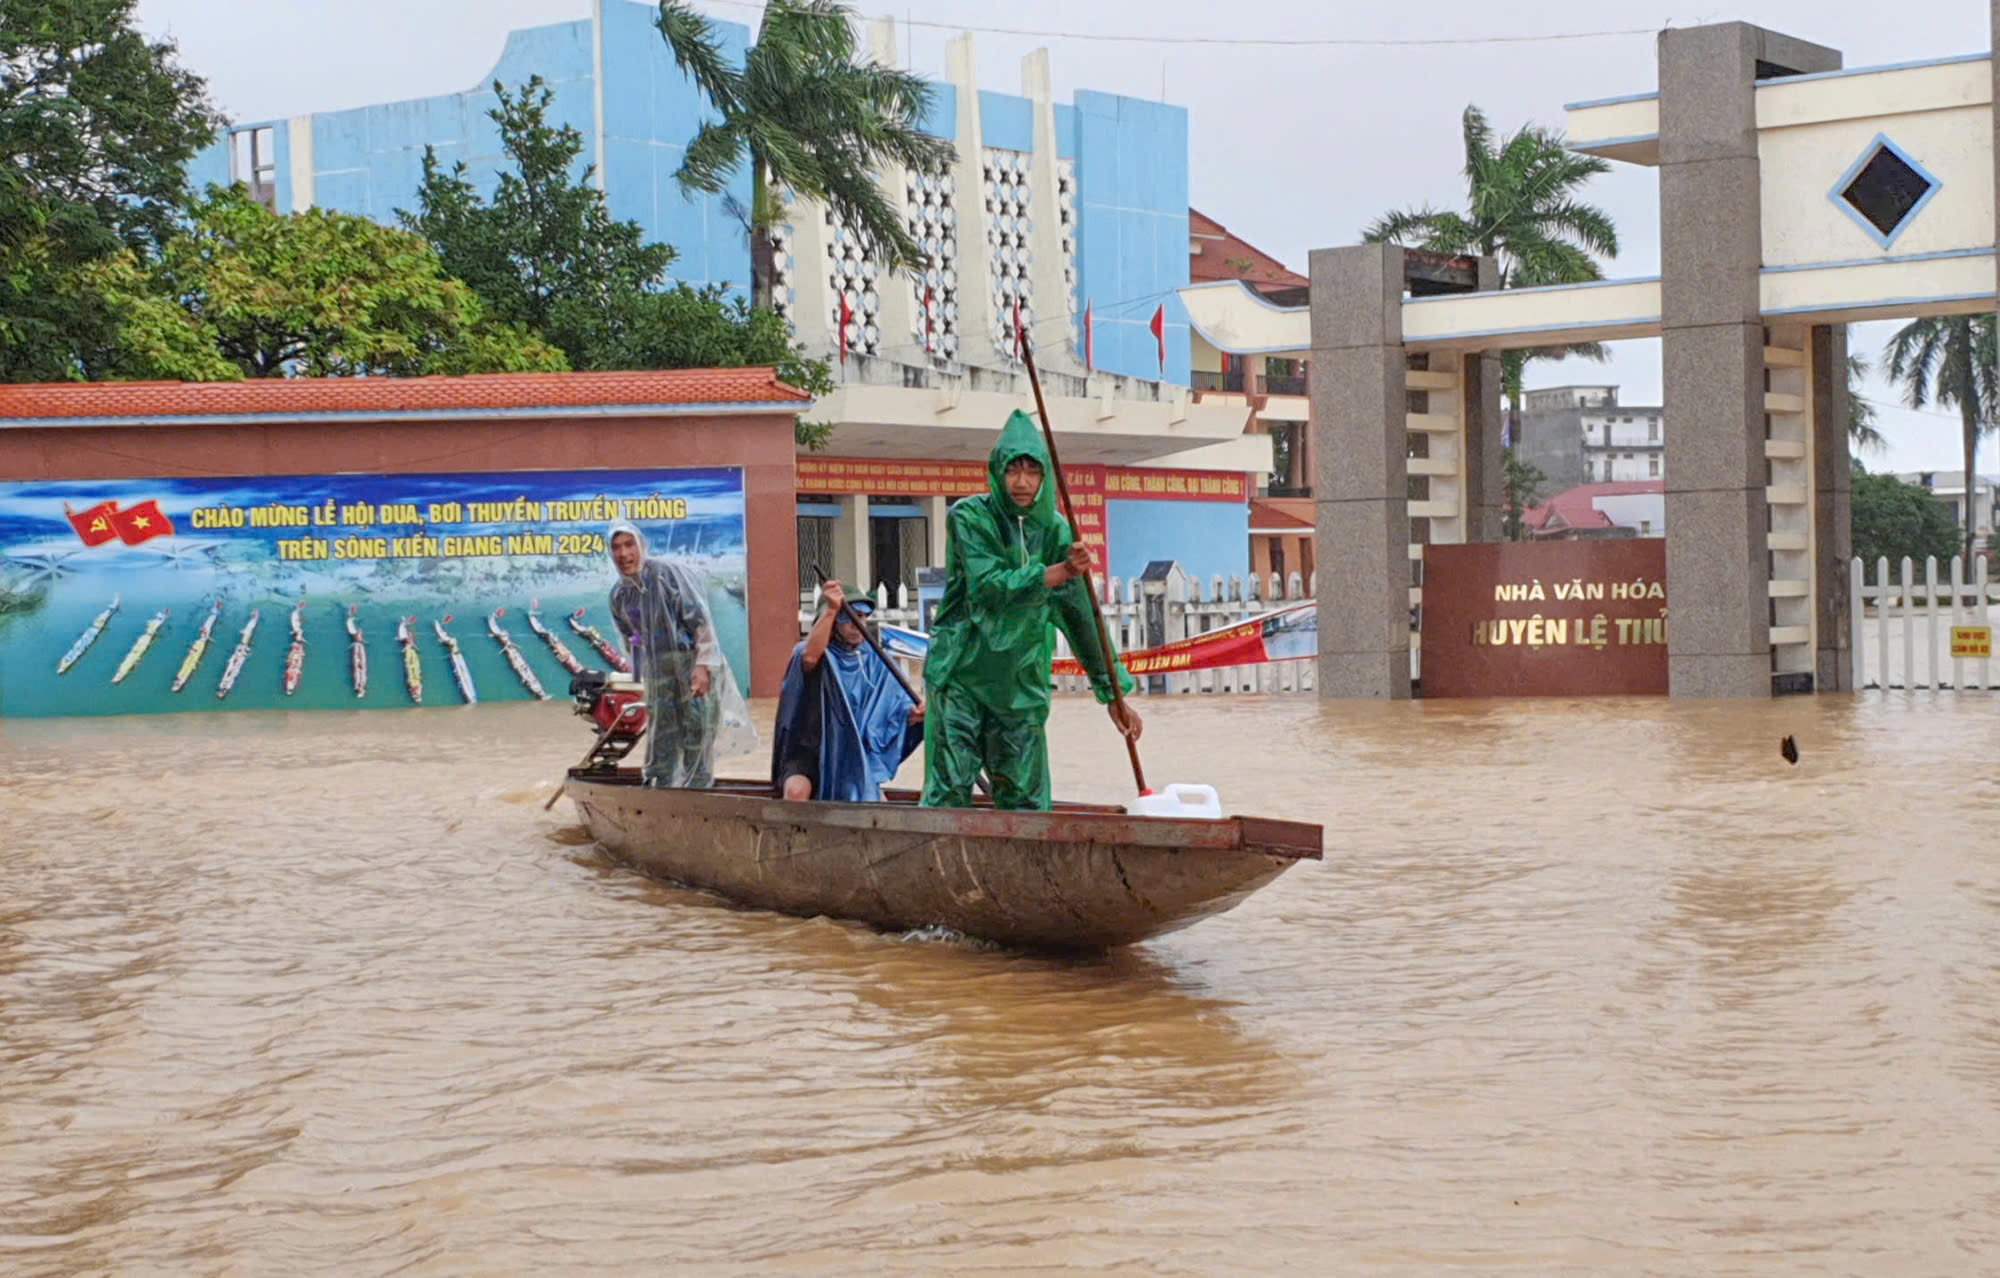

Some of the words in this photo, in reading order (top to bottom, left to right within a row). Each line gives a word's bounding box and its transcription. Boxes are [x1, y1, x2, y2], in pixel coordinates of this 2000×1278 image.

[191, 504, 245, 529] CHÀO
[250, 502, 309, 527] MỪNG
[314, 498, 337, 525] LỄ
[342, 501, 374, 530] HỘI
[380, 504, 424, 526] ĐUA,
[429, 501, 462, 524] BƠI
[468, 496, 541, 523] THUYỀN
[546, 494, 619, 521] TRUYỀN
[624, 491, 687, 520] THỐNG
[278, 536, 329, 560] TRÊN
[334, 535, 387, 559] SÔNG
[392, 531, 438, 558] KIẾN
[444, 535, 503, 557] GIANG
[508, 531, 552, 556] NĂM
[559, 535, 604, 555] 2024
[1495, 579, 1545, 601] NHÀ
[1553, 578, 1604, 600] VĂN
[1611, 577, 1665, 599] HÓA
[1473, 613, 1567, 650] HUYỆN
[1574, 613, 1608, 650] LỆ
[1615, 608, 1668, 645] THỦ
